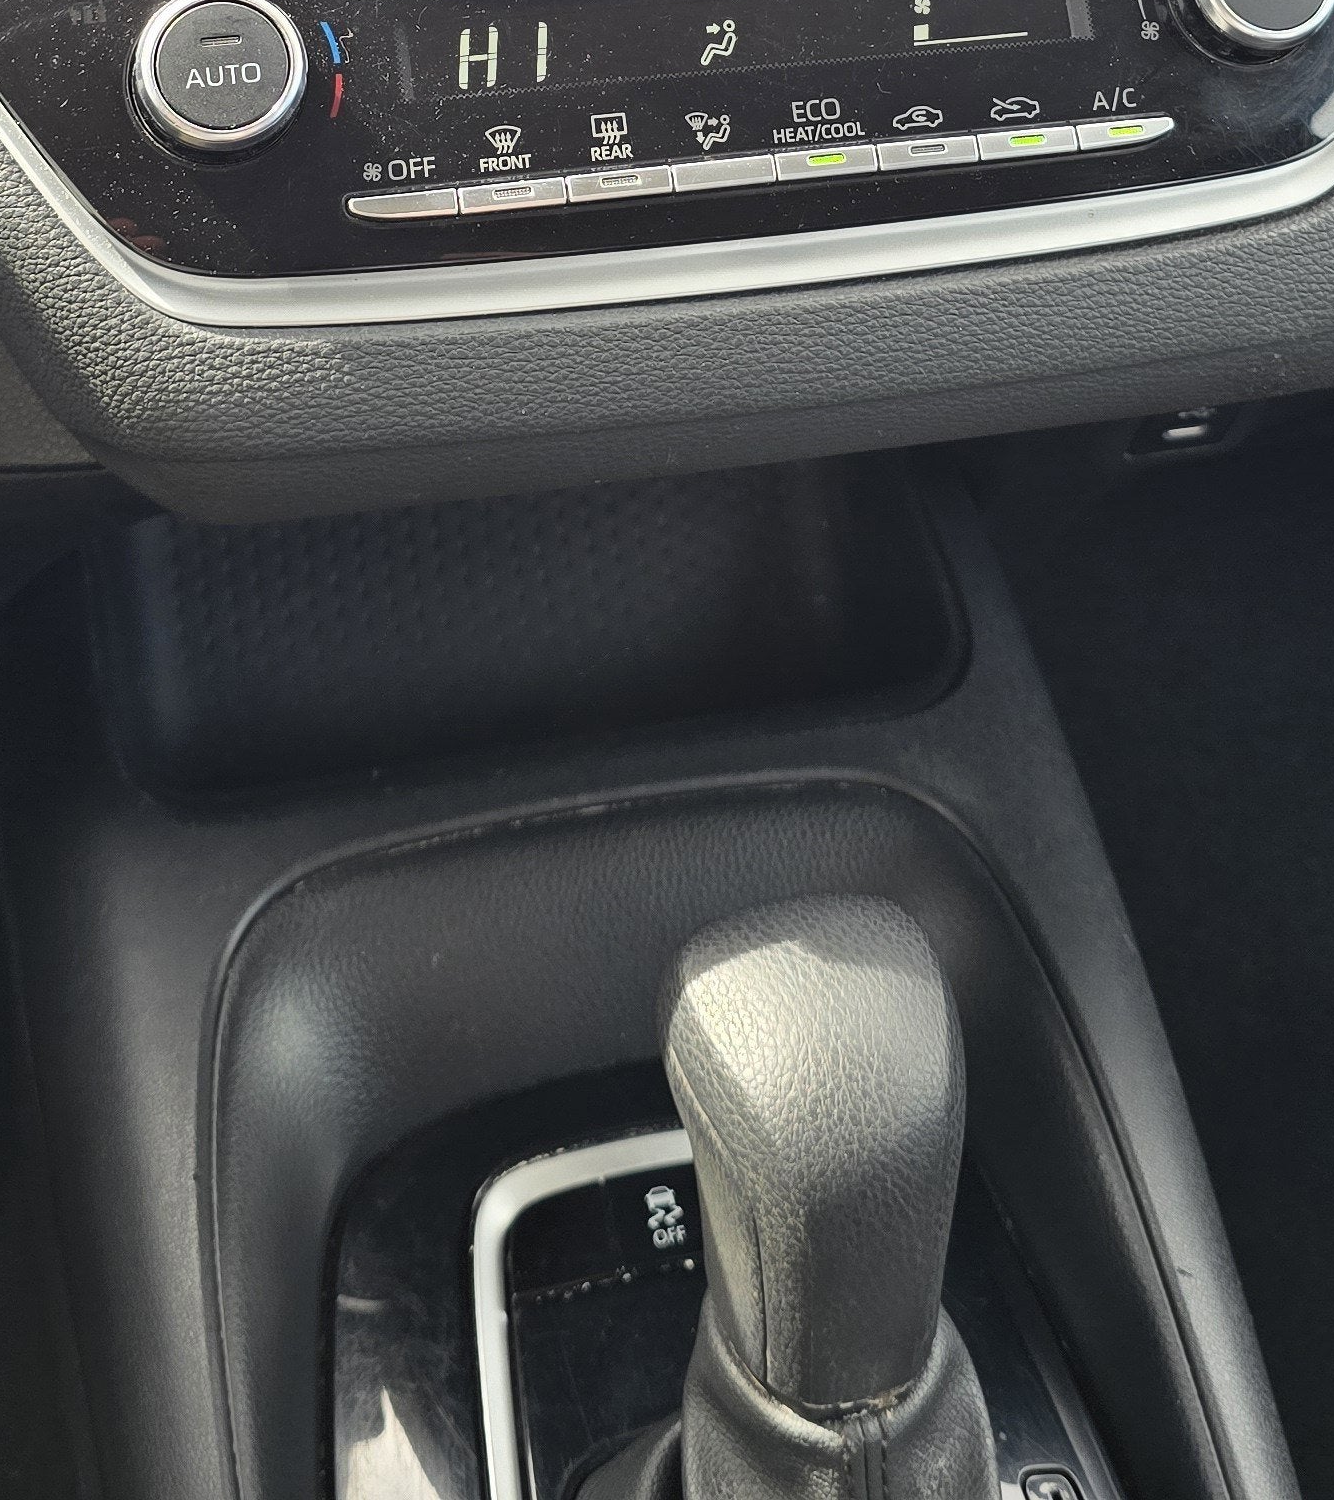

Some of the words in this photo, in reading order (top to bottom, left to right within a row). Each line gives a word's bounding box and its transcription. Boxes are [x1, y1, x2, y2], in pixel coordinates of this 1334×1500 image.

[457, 21, 549, 91] HI
[184, 61, 262, 90] AUTO
[791, 97, 841, 125] ECO
[1092, 86, 1138, 112] A/C
[772, 120, 866, 145] HEAT/COOL
[478, 153, 532, 173] FRONT
[590, 142, 634, 163] REAR
[387, 156, 437, 182] OFF
[652, 1225, 687, 1250] OFF
